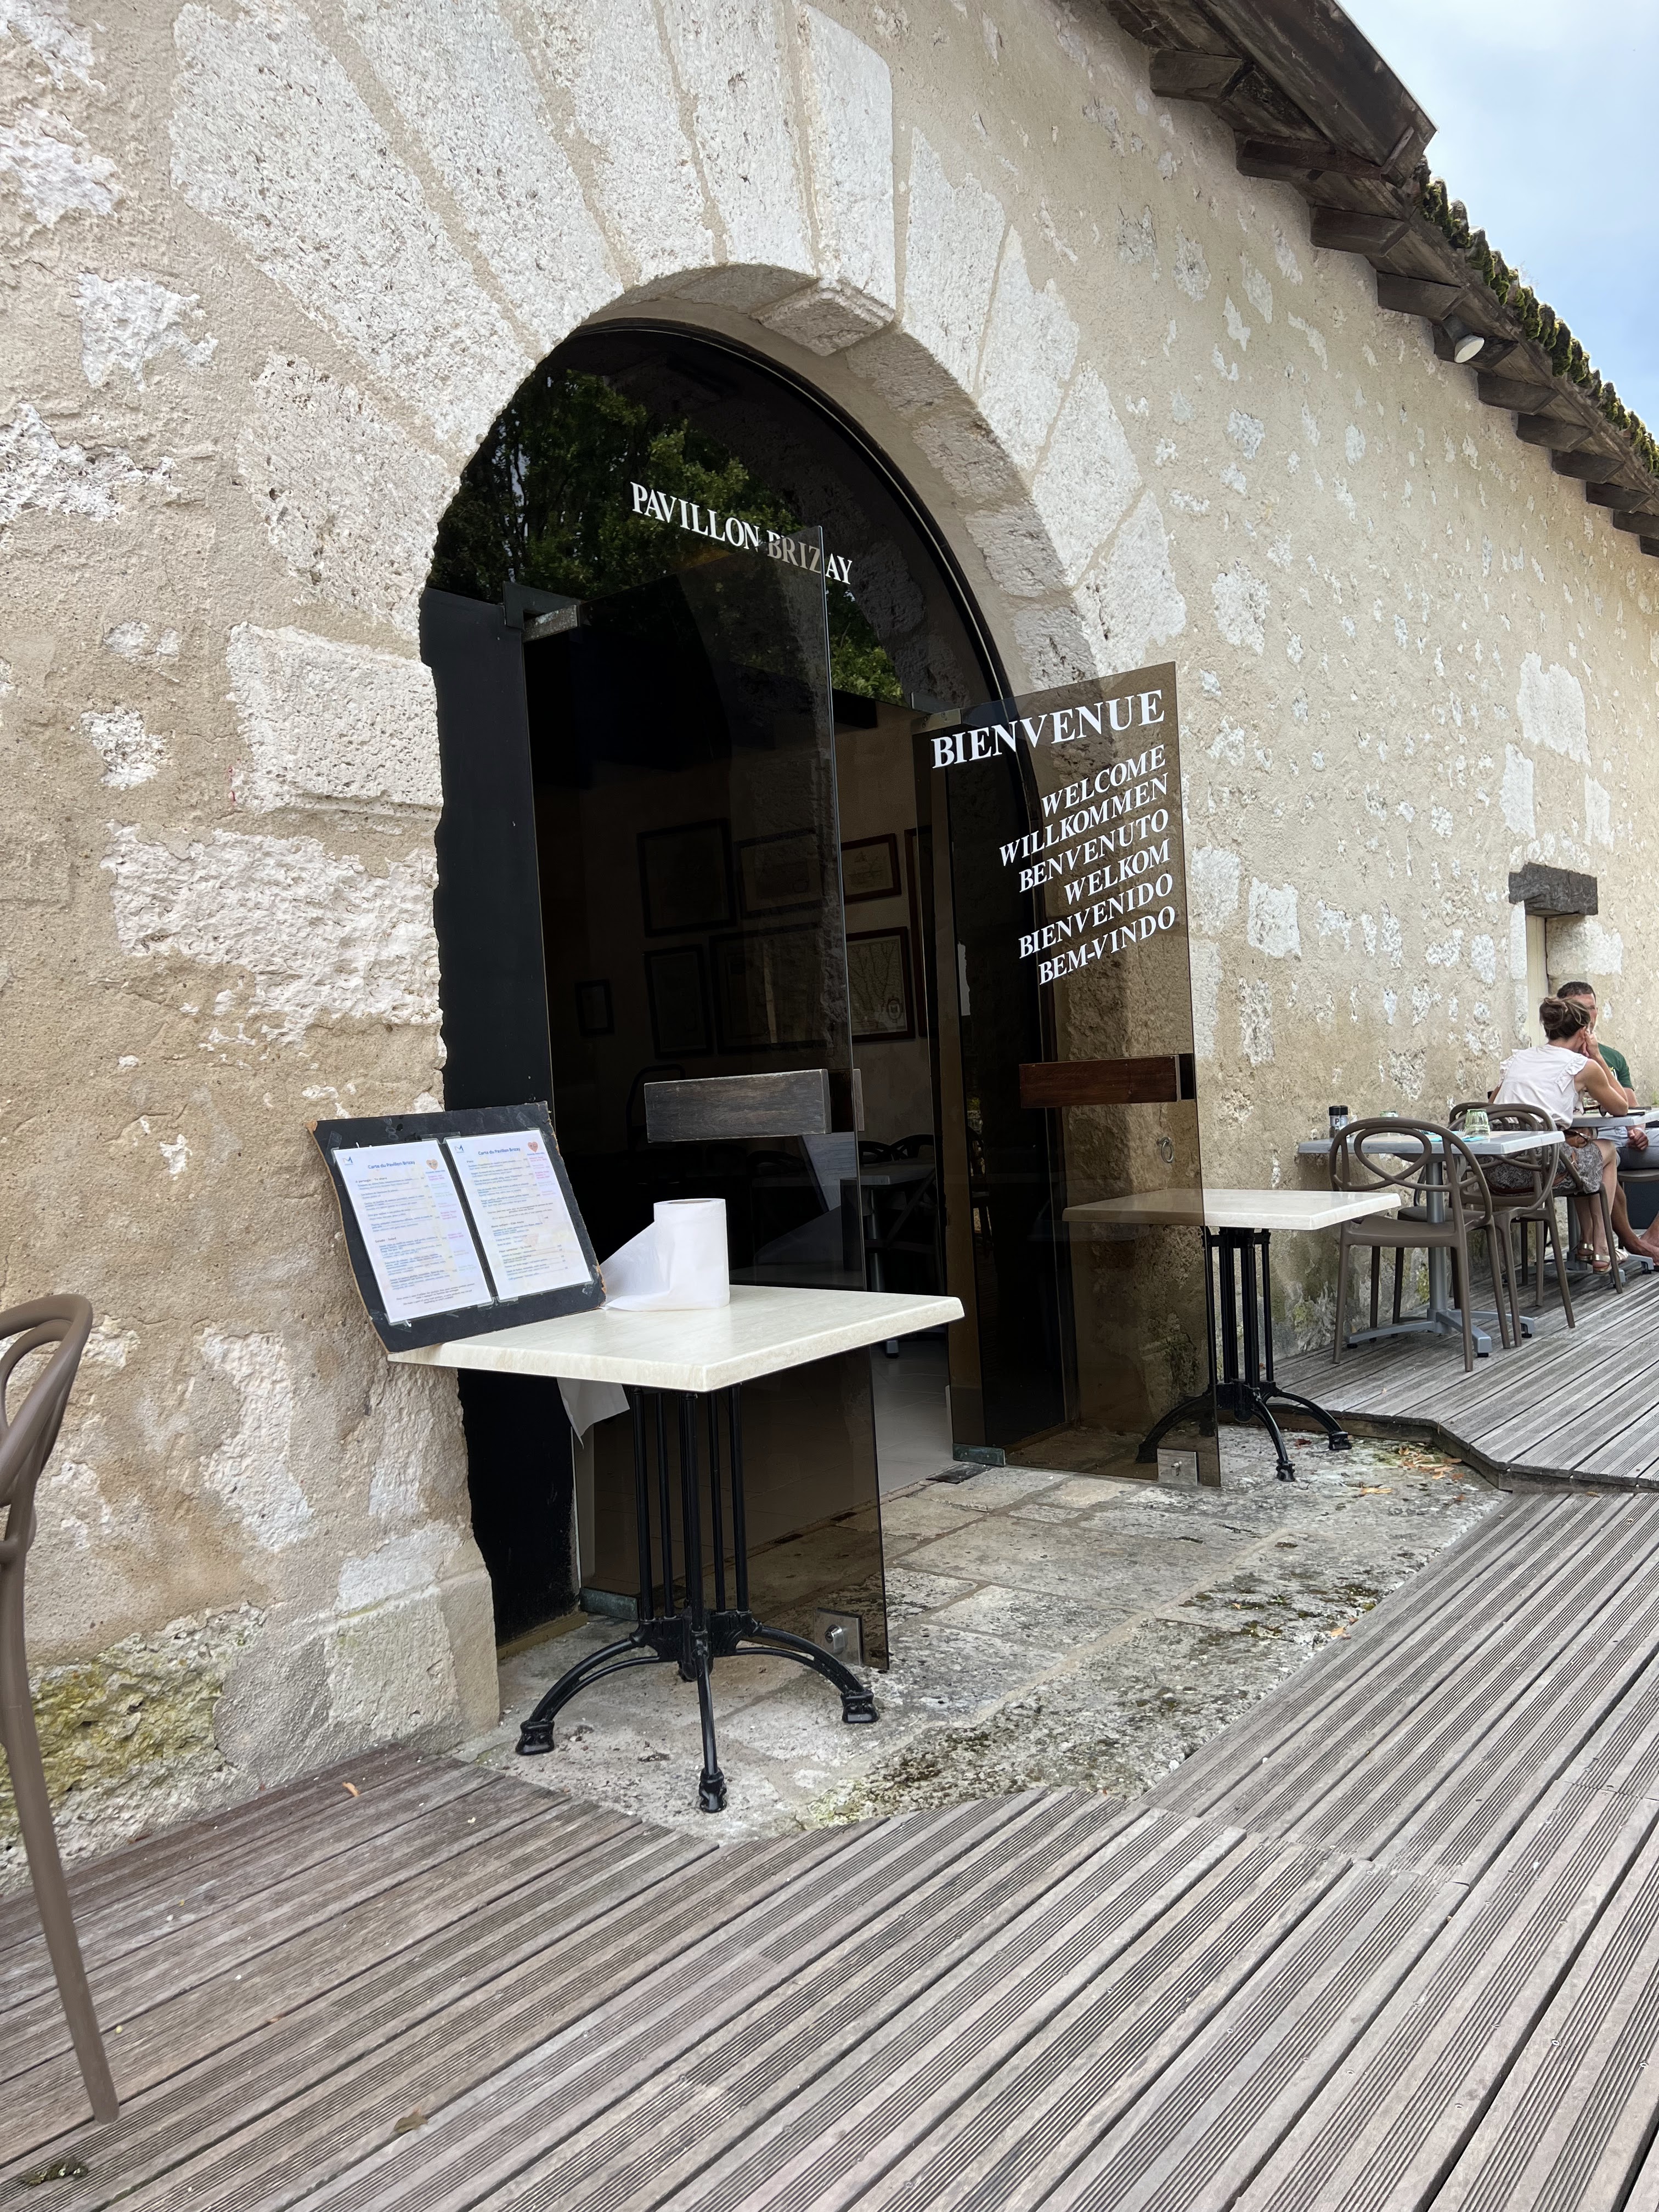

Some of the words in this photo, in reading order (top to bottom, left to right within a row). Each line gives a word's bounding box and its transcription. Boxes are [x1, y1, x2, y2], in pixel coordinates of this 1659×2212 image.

[630, 481, 760, 550] PAVILLON
[766, 529, 853, 585] BRIZAY
[930, 689, 1165, 769] BIENVENUE
[999, 772, 1169, 867] WILLKOMMEN
[1041, 744, 1166, 817] WELCOME
[1018, 808, 1169, 893] BENVENUTO
[1064, 838, 1171, 905] WELKOM
[1018, 873, 1173, 959] BIENVENIDO
[1038, 906, 1176, 985] BEM-VINDO
